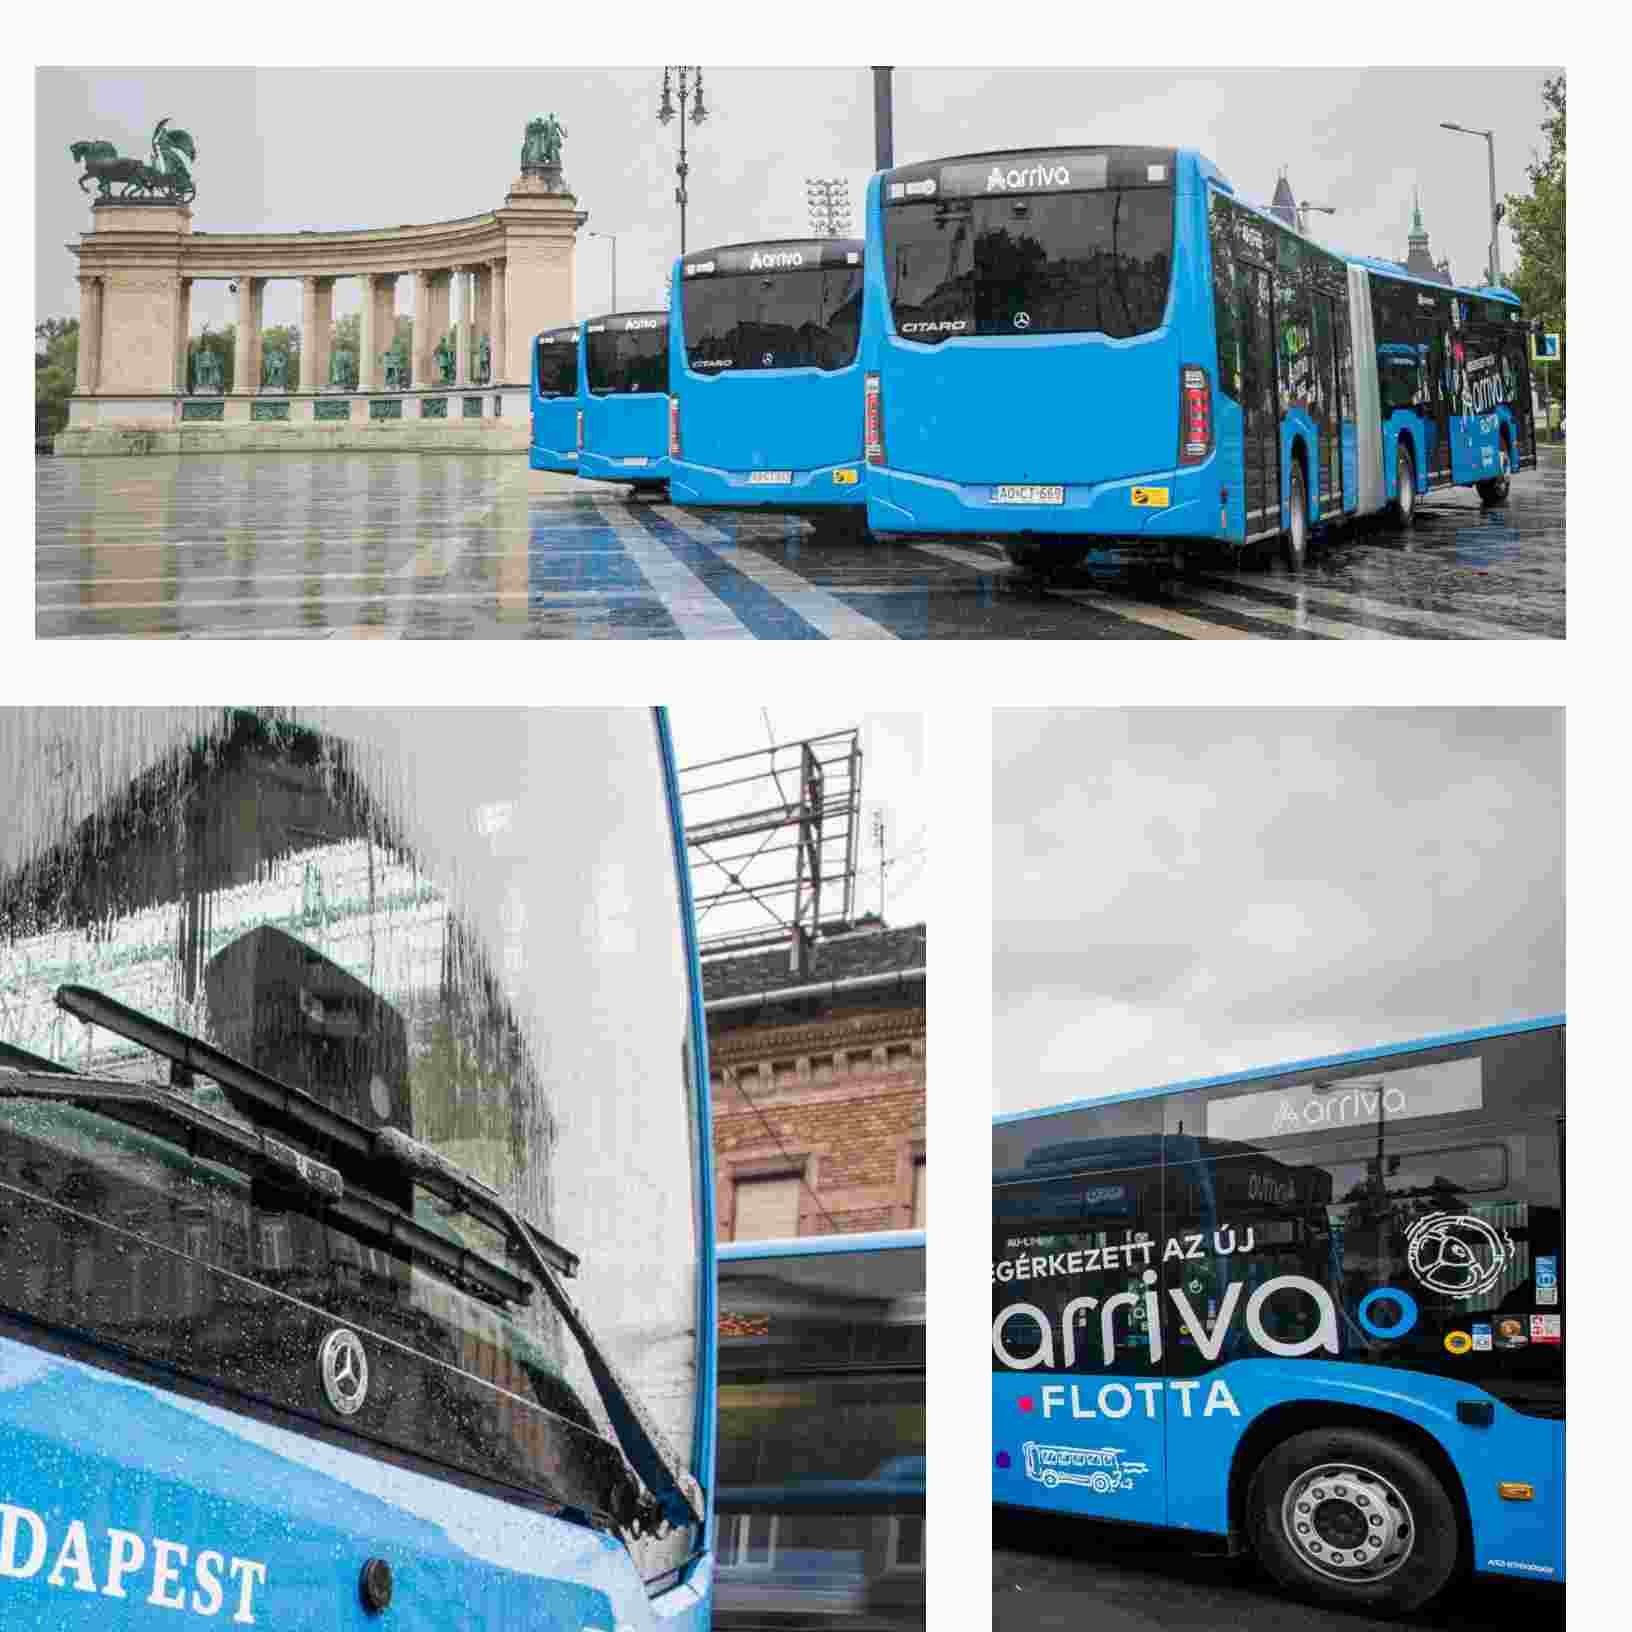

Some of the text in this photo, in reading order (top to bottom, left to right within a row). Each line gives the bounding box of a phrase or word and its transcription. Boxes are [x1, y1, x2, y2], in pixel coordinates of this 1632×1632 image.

[1163, 1233, 1206, 1263] AZ
[1213, 1223, 1256, 1256] ÚJ
[992, 1270, 1341, 1371] arriva
[1040, 1378, 1241, 1419] FLOTTA
